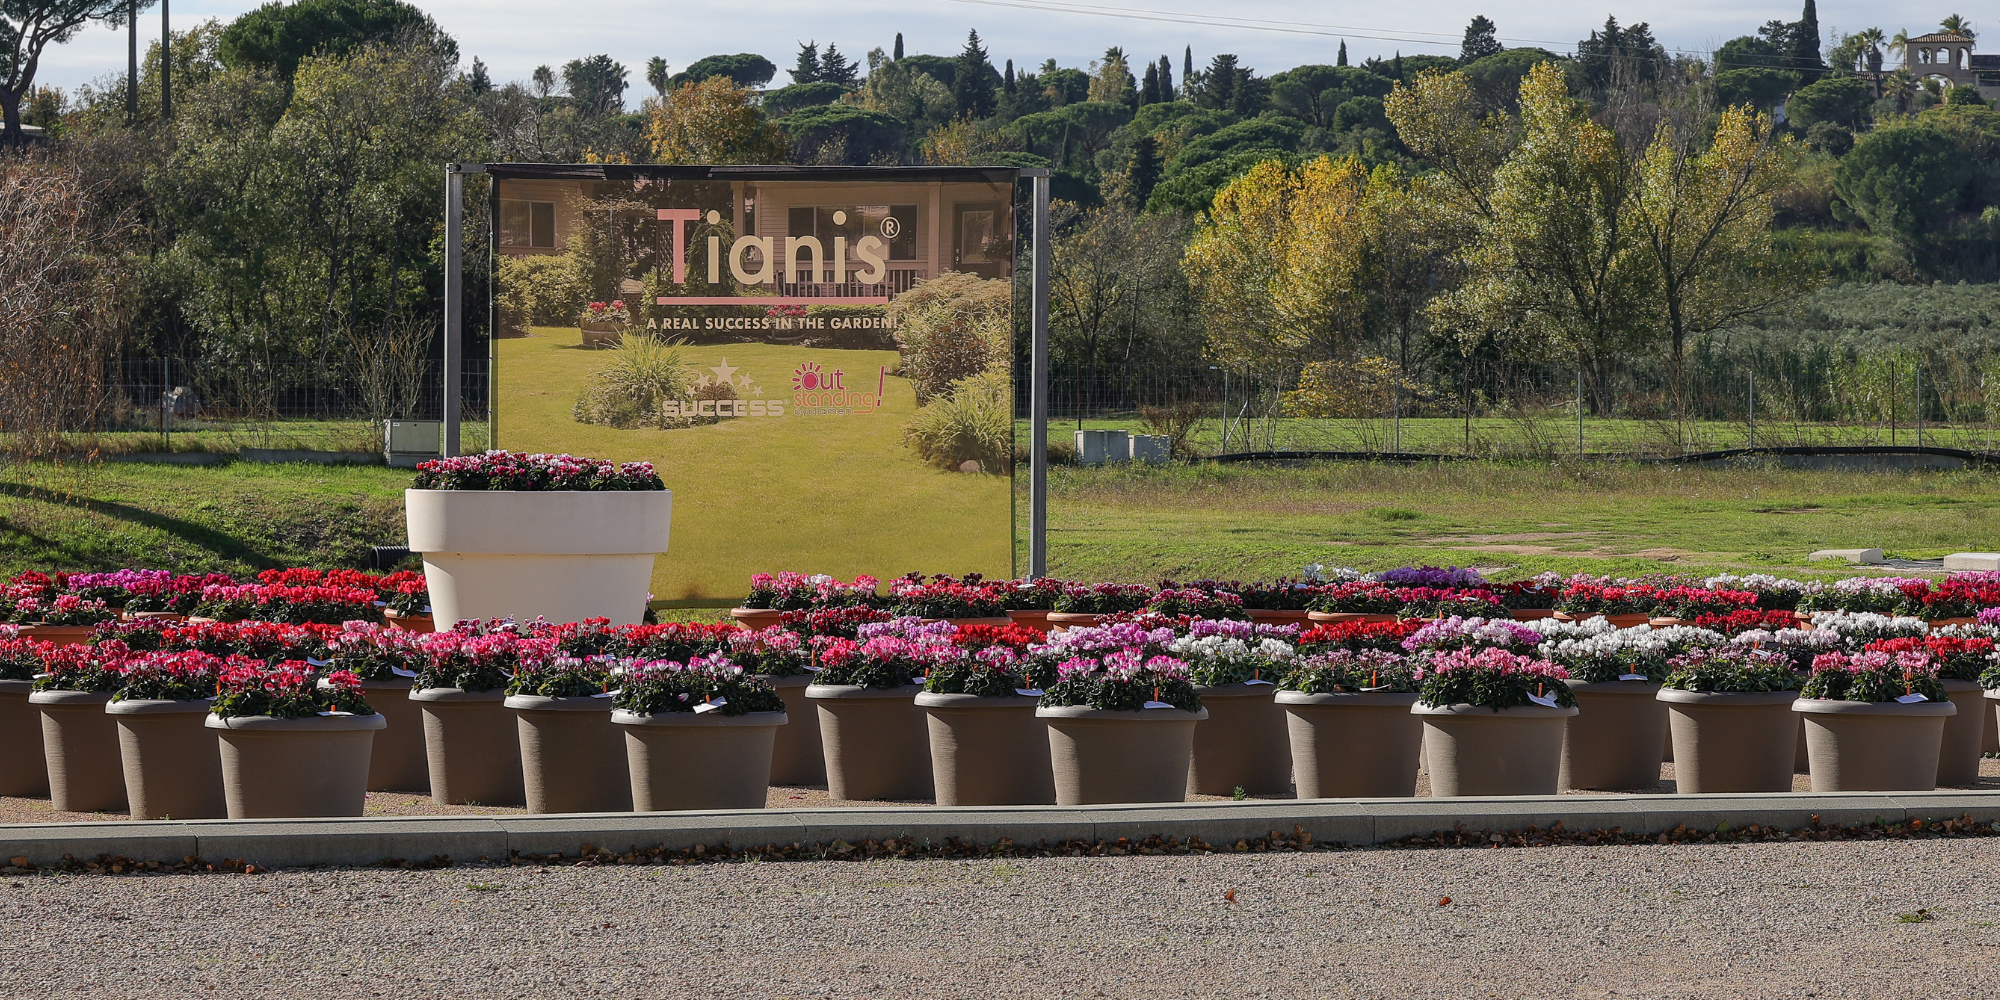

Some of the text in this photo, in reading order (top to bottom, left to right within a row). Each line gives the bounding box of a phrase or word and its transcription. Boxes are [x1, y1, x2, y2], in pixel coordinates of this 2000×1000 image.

[646, 317, 898, 330] A REAL SUCCESS IN THE GARDEN!
[794, 407, 853, 416] cyclamen
